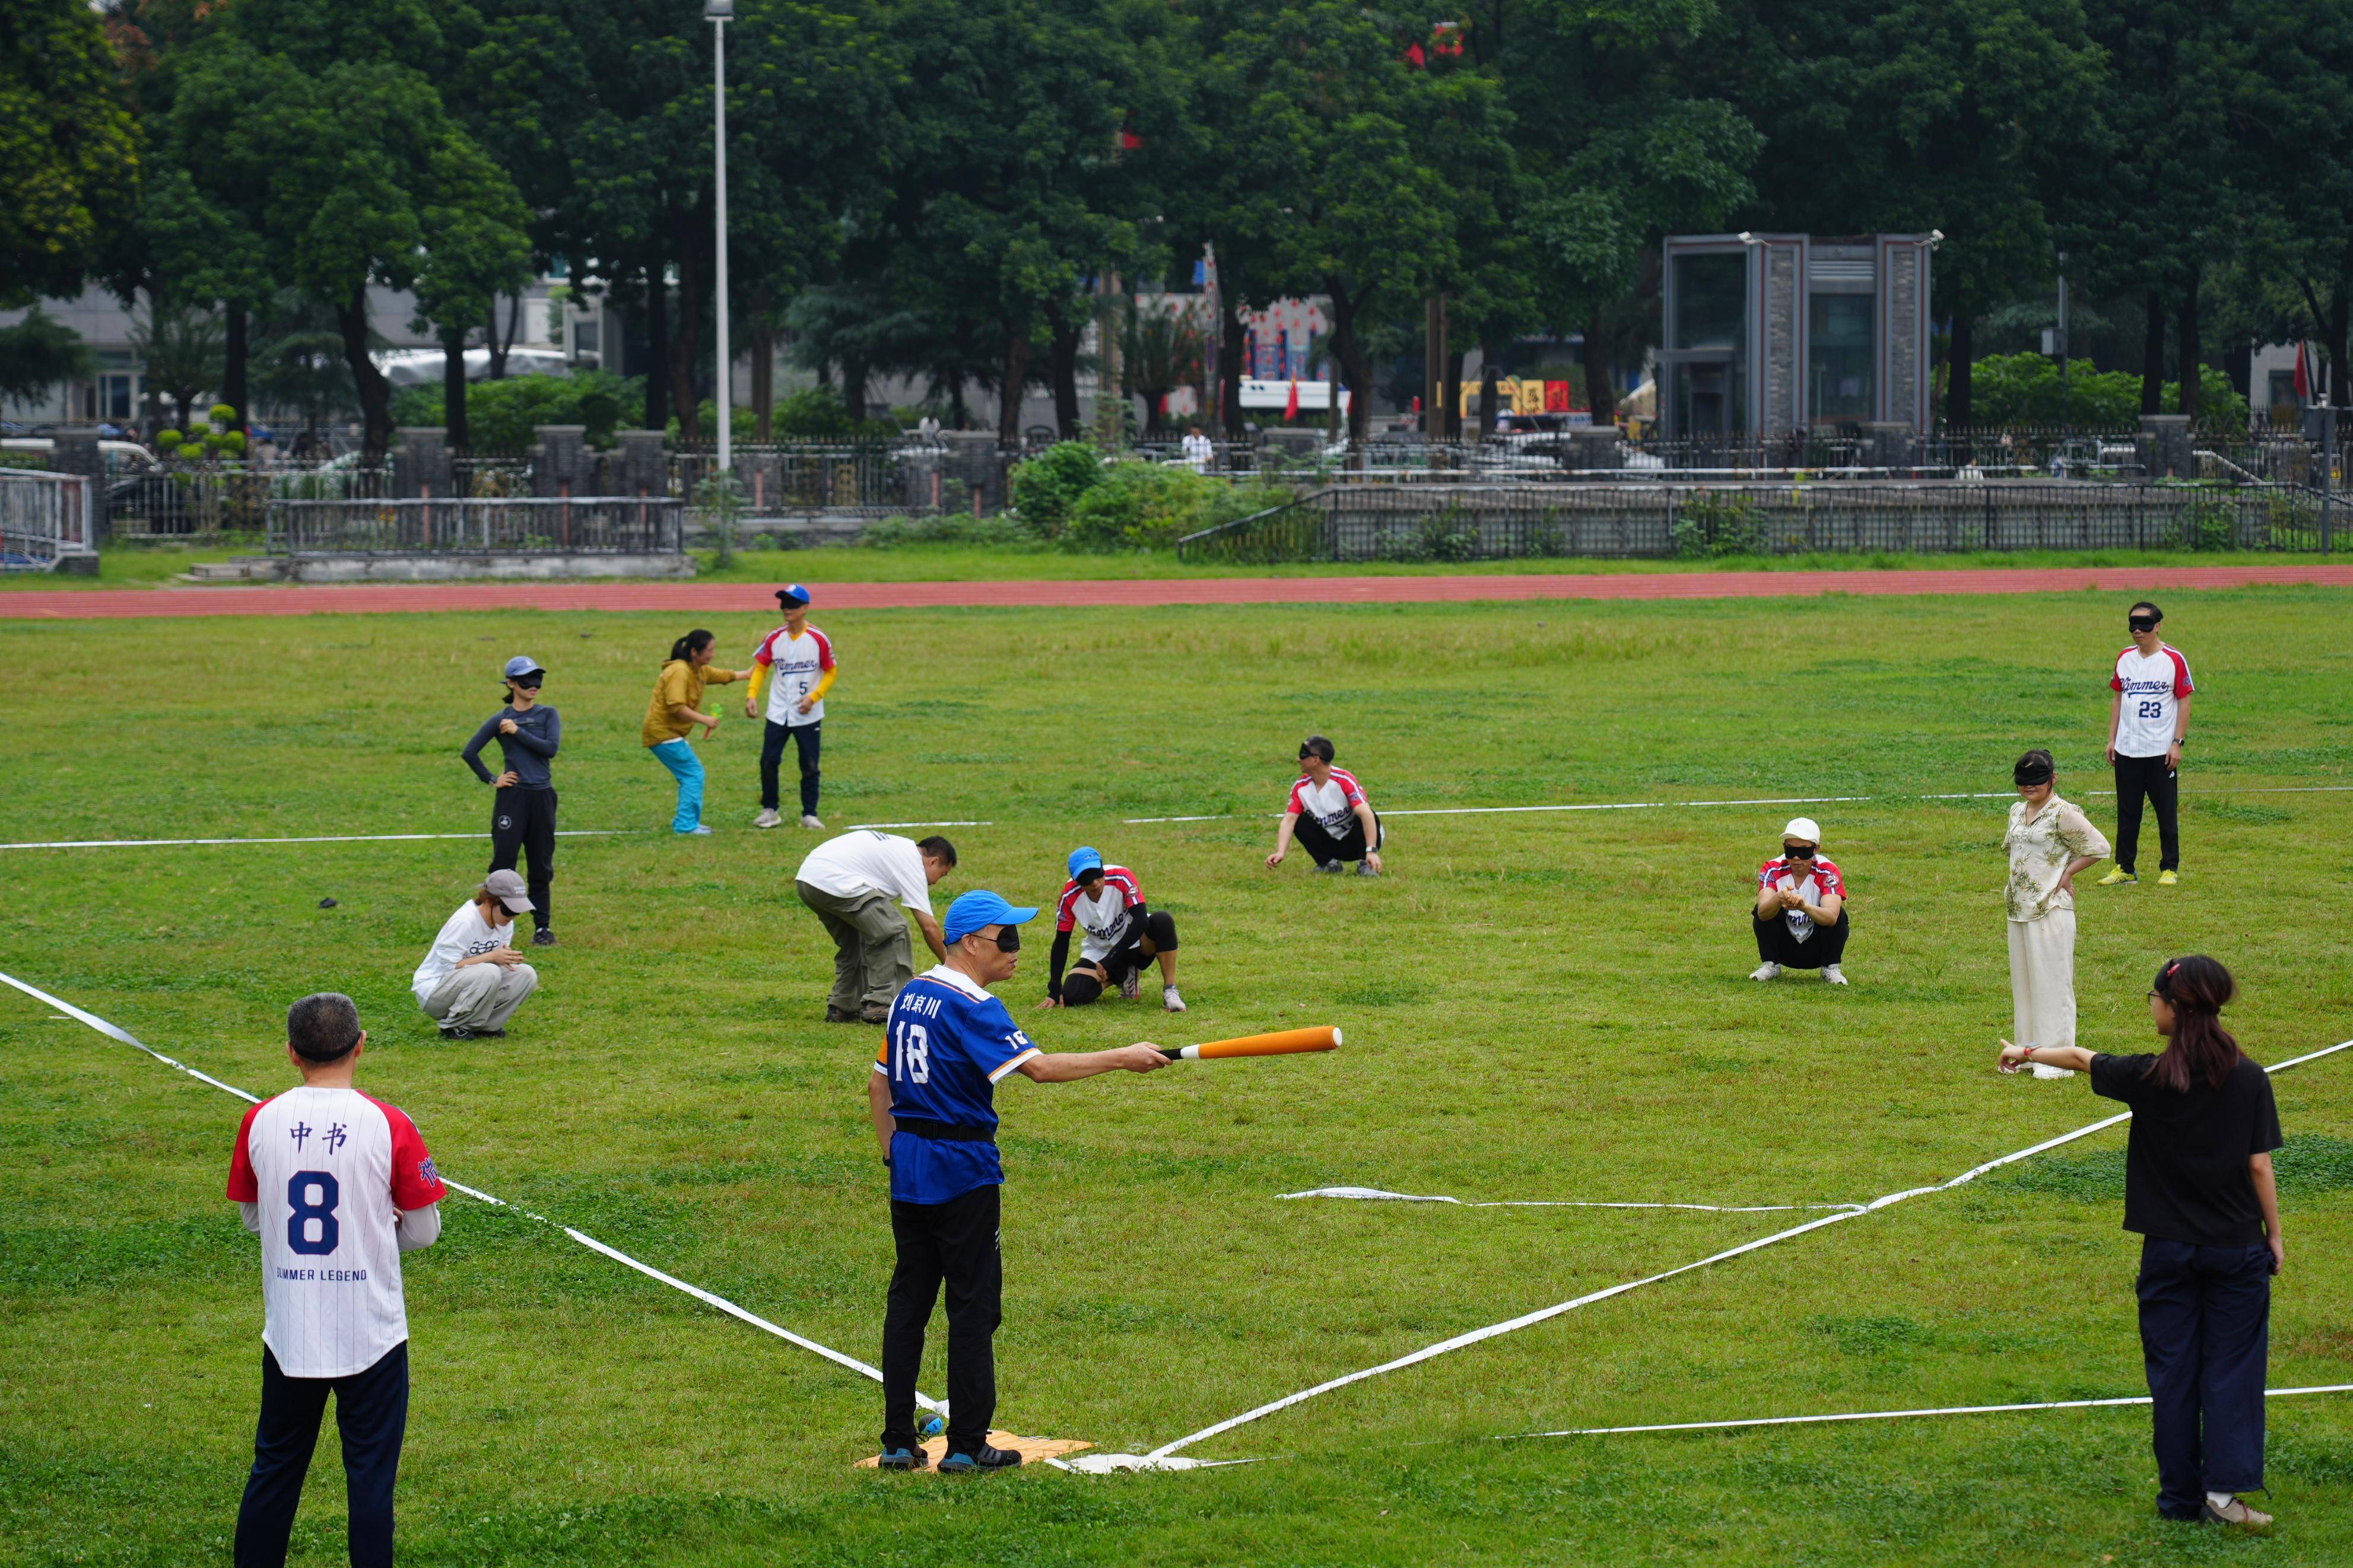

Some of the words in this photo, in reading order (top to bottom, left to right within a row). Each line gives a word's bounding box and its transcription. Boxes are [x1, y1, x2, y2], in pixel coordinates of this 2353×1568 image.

[799, 682, 808, 695] 5
[2139, 701, 2161, 718] 23
[1005, 1030, 1028, 1050] 18
[896, 1020, 930, 1084] 18
[289, 1121, 347, 1156] 中书
[288, 1170, 339, 1255] 8
[320, 1269, 367, 1281] LEGEND
